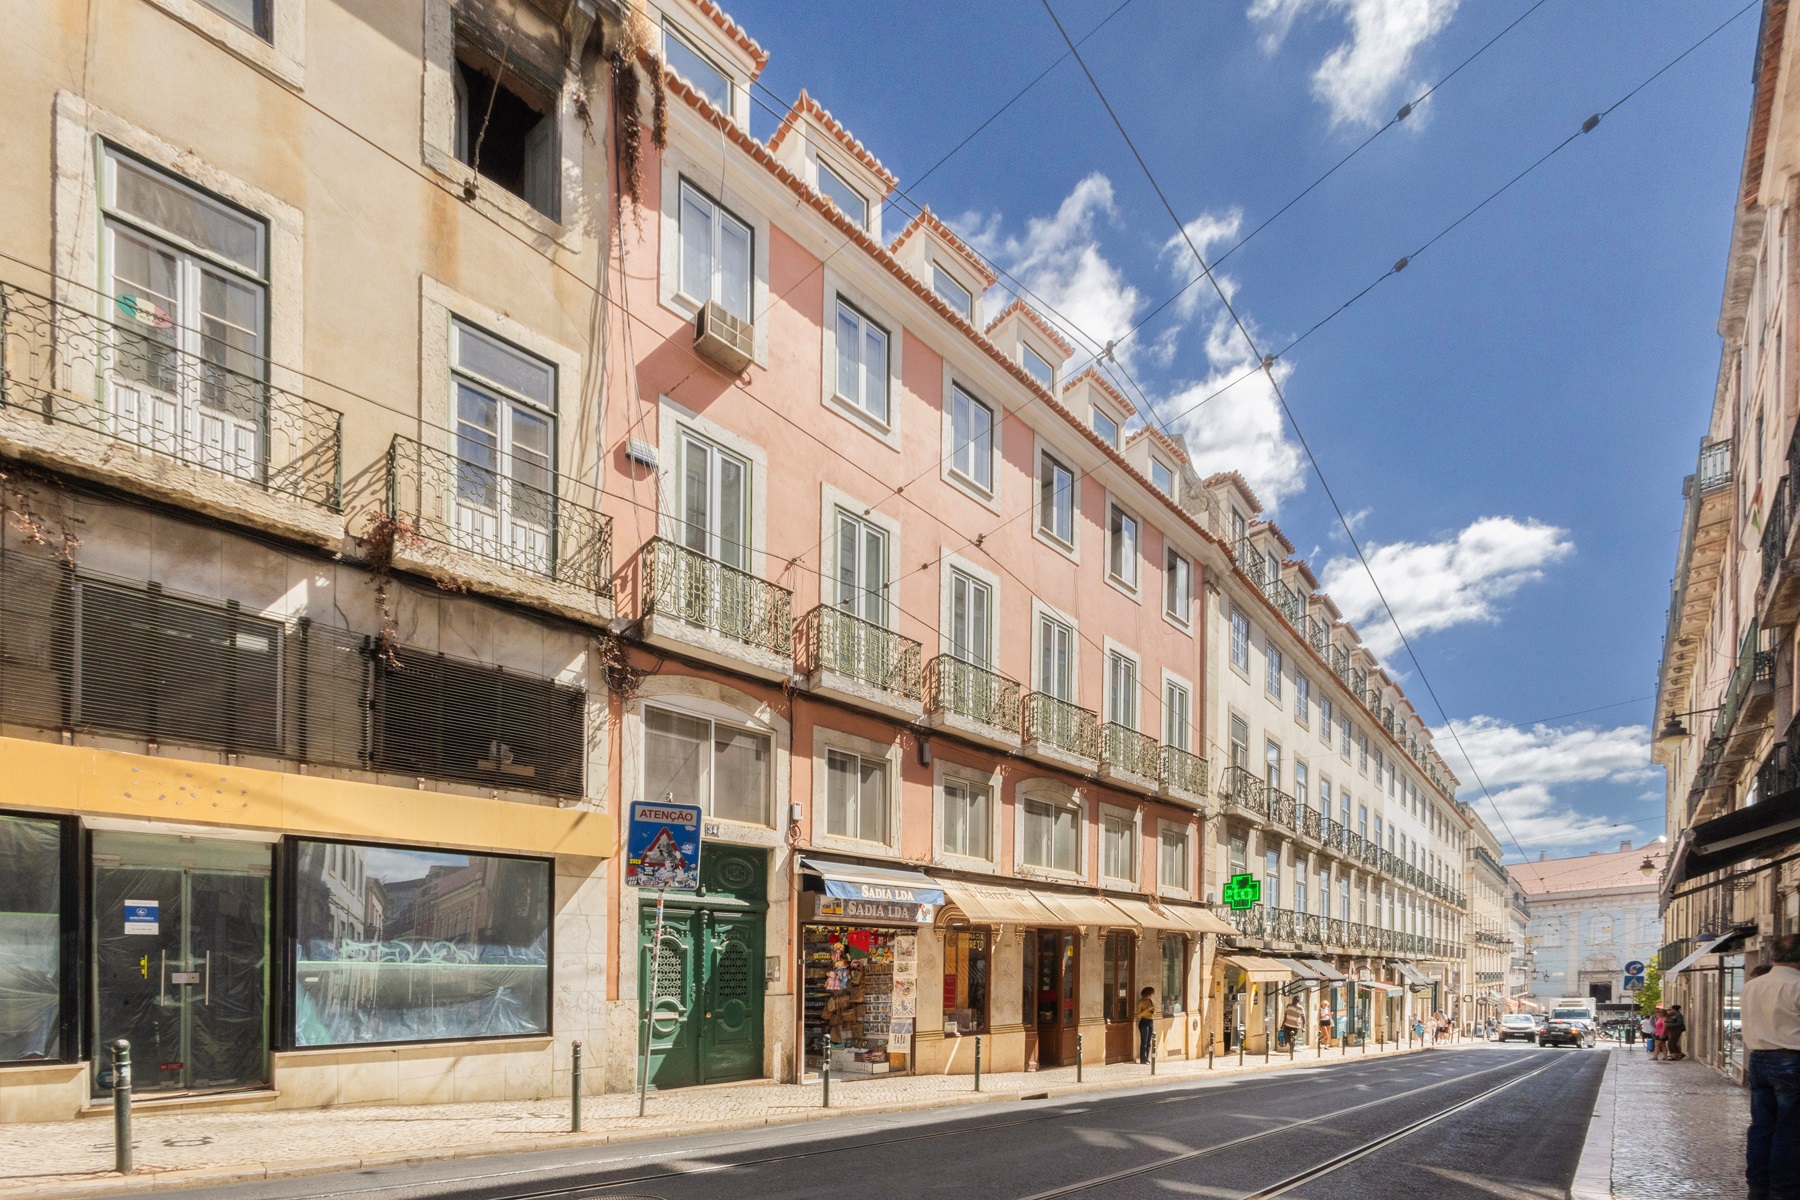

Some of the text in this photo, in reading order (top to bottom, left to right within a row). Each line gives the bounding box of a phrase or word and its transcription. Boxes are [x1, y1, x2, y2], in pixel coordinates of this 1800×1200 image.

[639, 809, 693, 822] ATENÇÃO
[706, 825, 718, 835] 34
[861, 885, 914, 901] SADIA LDA
[848, 900, 909, 919] SADIA LDA
